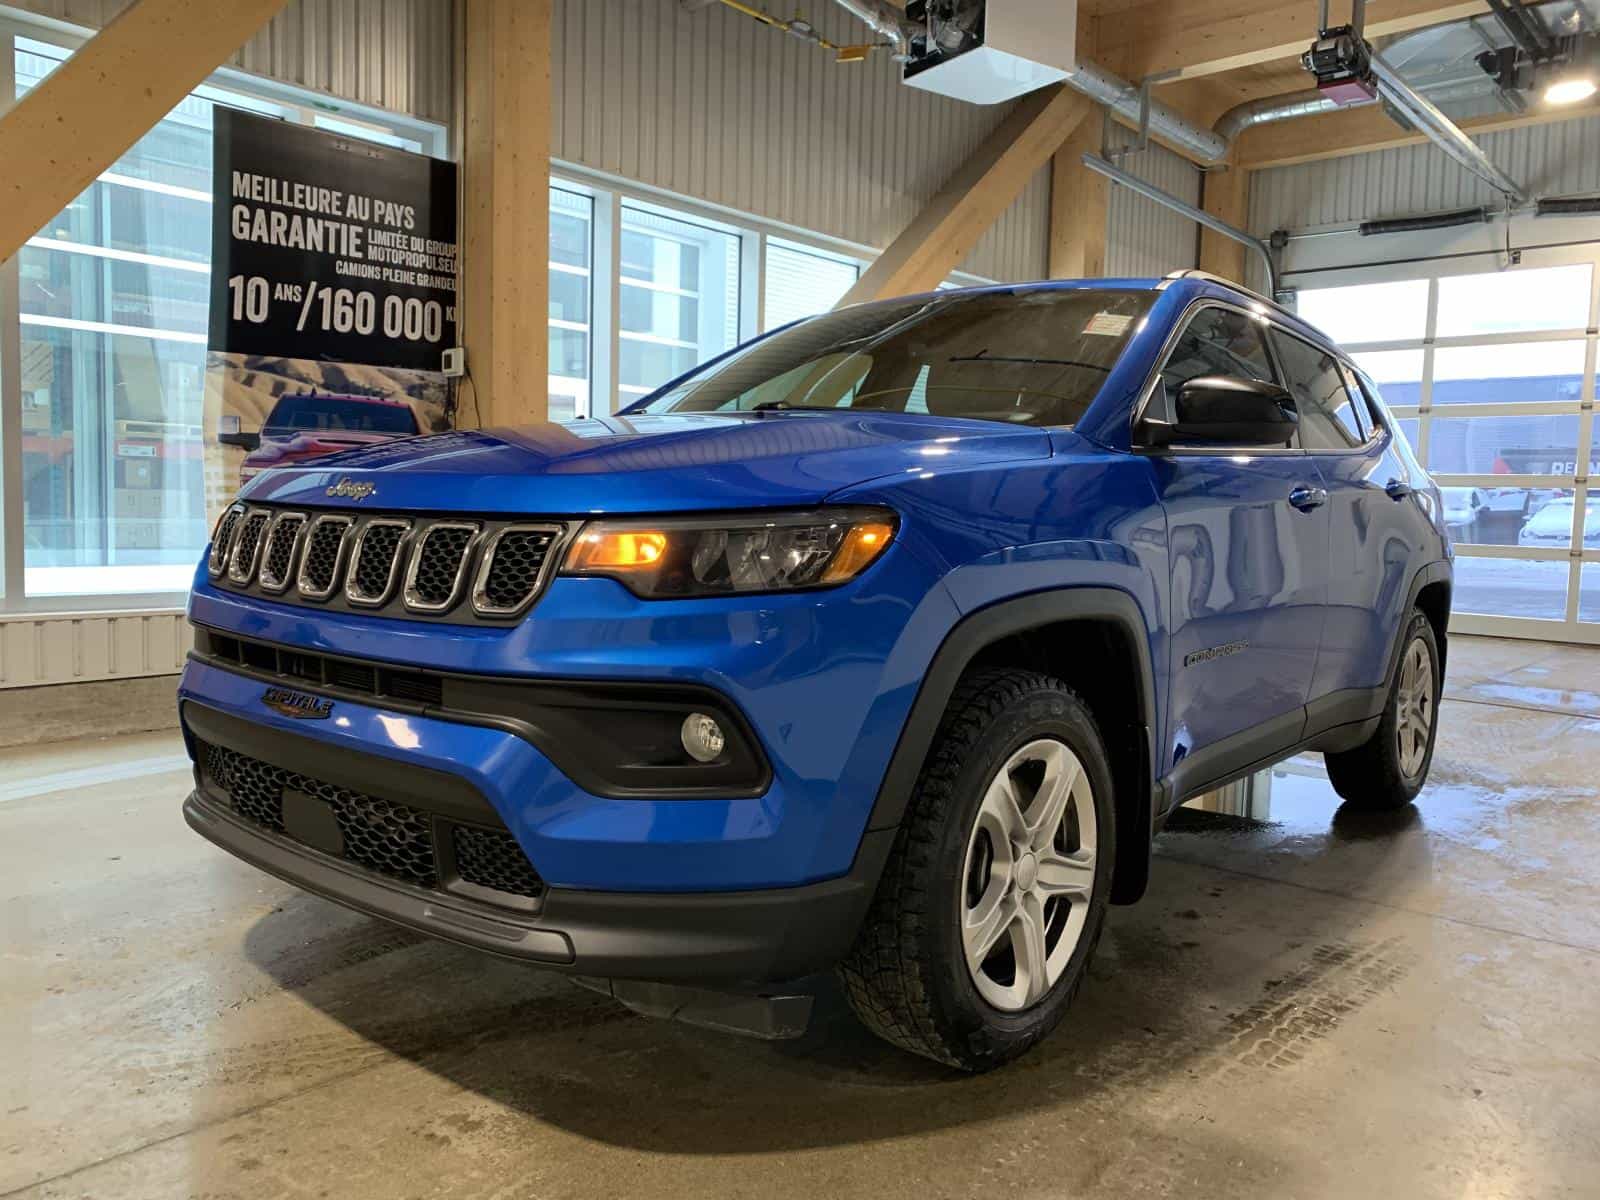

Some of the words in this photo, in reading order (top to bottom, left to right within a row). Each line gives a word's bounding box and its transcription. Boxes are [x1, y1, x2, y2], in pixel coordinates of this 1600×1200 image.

[232, 171, 342, 216] MEILLEURE
[346, 194, 370, 221] AU
[374, 202, 415, 230] PAYS
[232, 204, 364, 258] GARANTIE
[368, 229, 408, 251] LIMITÉE
[410, 238, 425, 253] DU
[426, 240, 456, 259] GROUP
[336, 260, 381, 281] CAMIONS
[383, 268, 415, 285] PLEINE
[368, 246, 456, 274] MOTOPROPULSEU
[229, 275, 270, 324] 10
[274, 283, 302, 303] ANS
